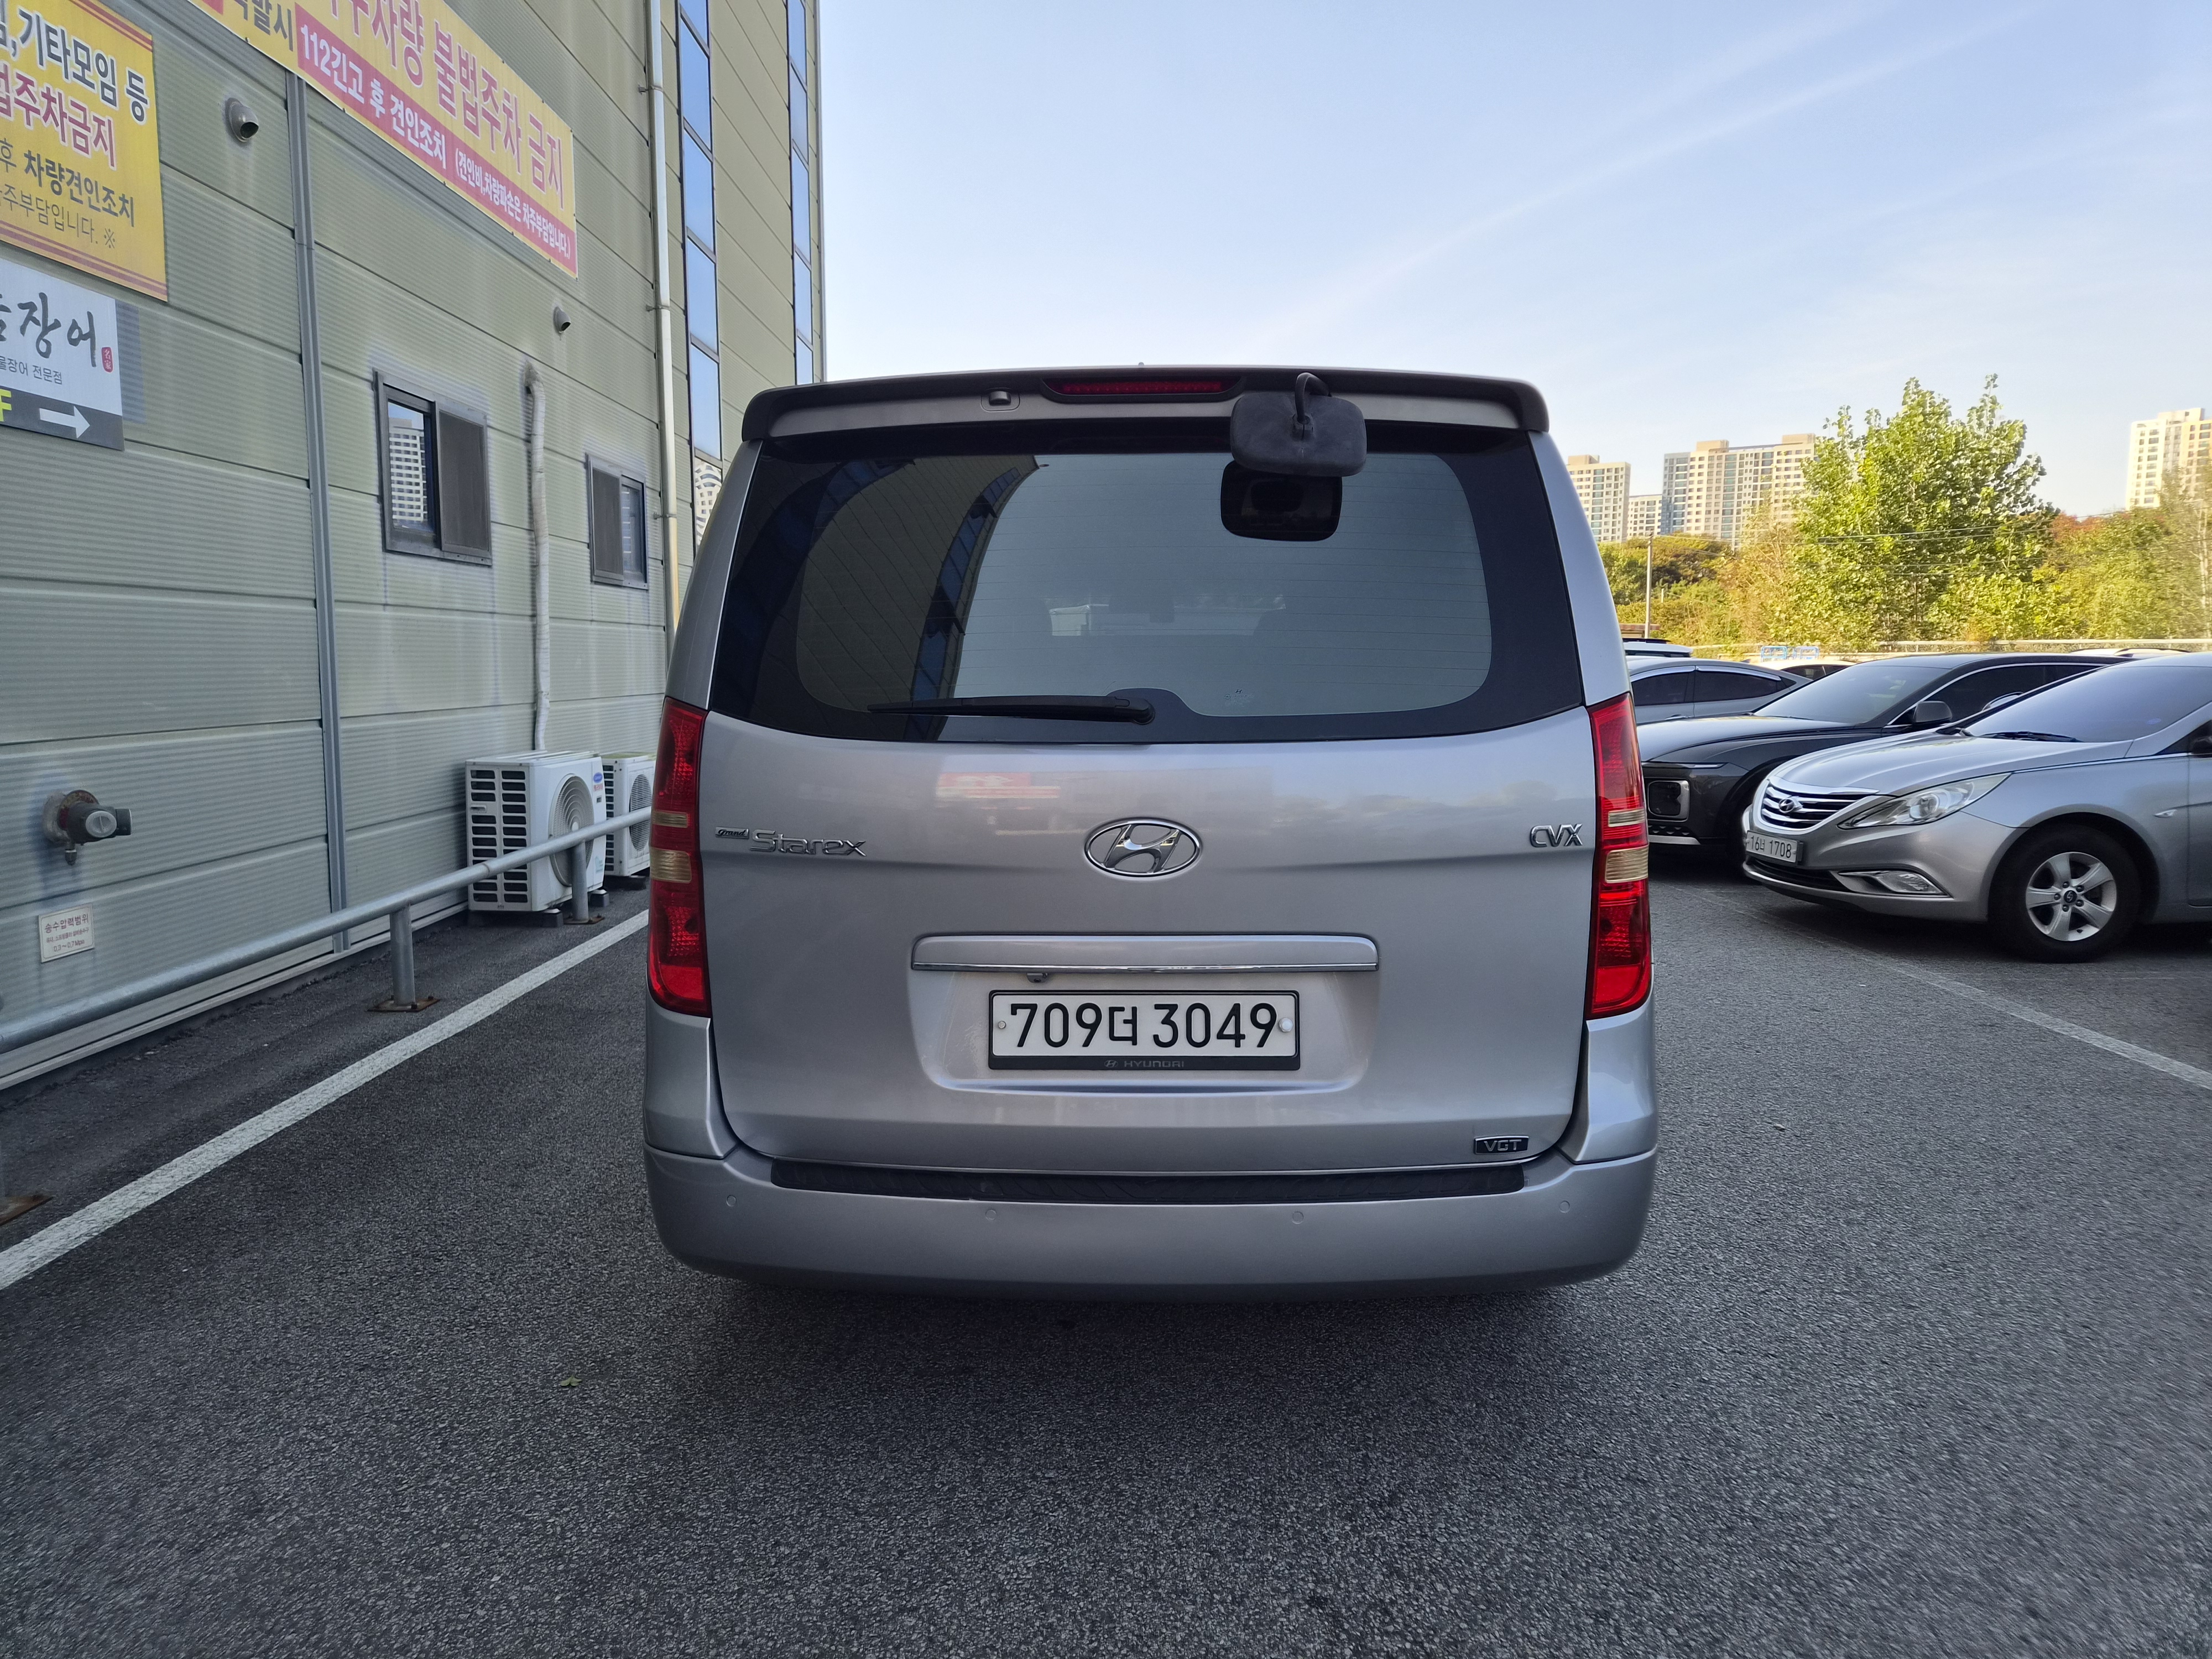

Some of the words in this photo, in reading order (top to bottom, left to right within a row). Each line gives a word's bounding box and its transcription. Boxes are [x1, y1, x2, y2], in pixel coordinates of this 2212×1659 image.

[126, 70, 148, 122] 등
[370, 79, 385, 119] 후
[390, 94, 446, 170] 견인조치
[434, 20, 521, 175] 불법주차
[528, 112, 564, 211] 금지
[24, 150, 134, 227] 차량견인조치
[0, 184, 98, 244] 주부담입니다.
[33, 364, 62, 385] 전문점
[718, 829, 746, 837] Grand
[750, 829, 867, 857] Starex
[1530, 823, 1583, 848] CVX
[1769, 839, 1792, 858] 1708
[45, 914, 88, 933] 송수압력범위
[1010, 1003, 1138, 1048] 709더
[1152, 1003, 1278, 1048] 3049
[1484, 1139, 1522, 1151] VGT
